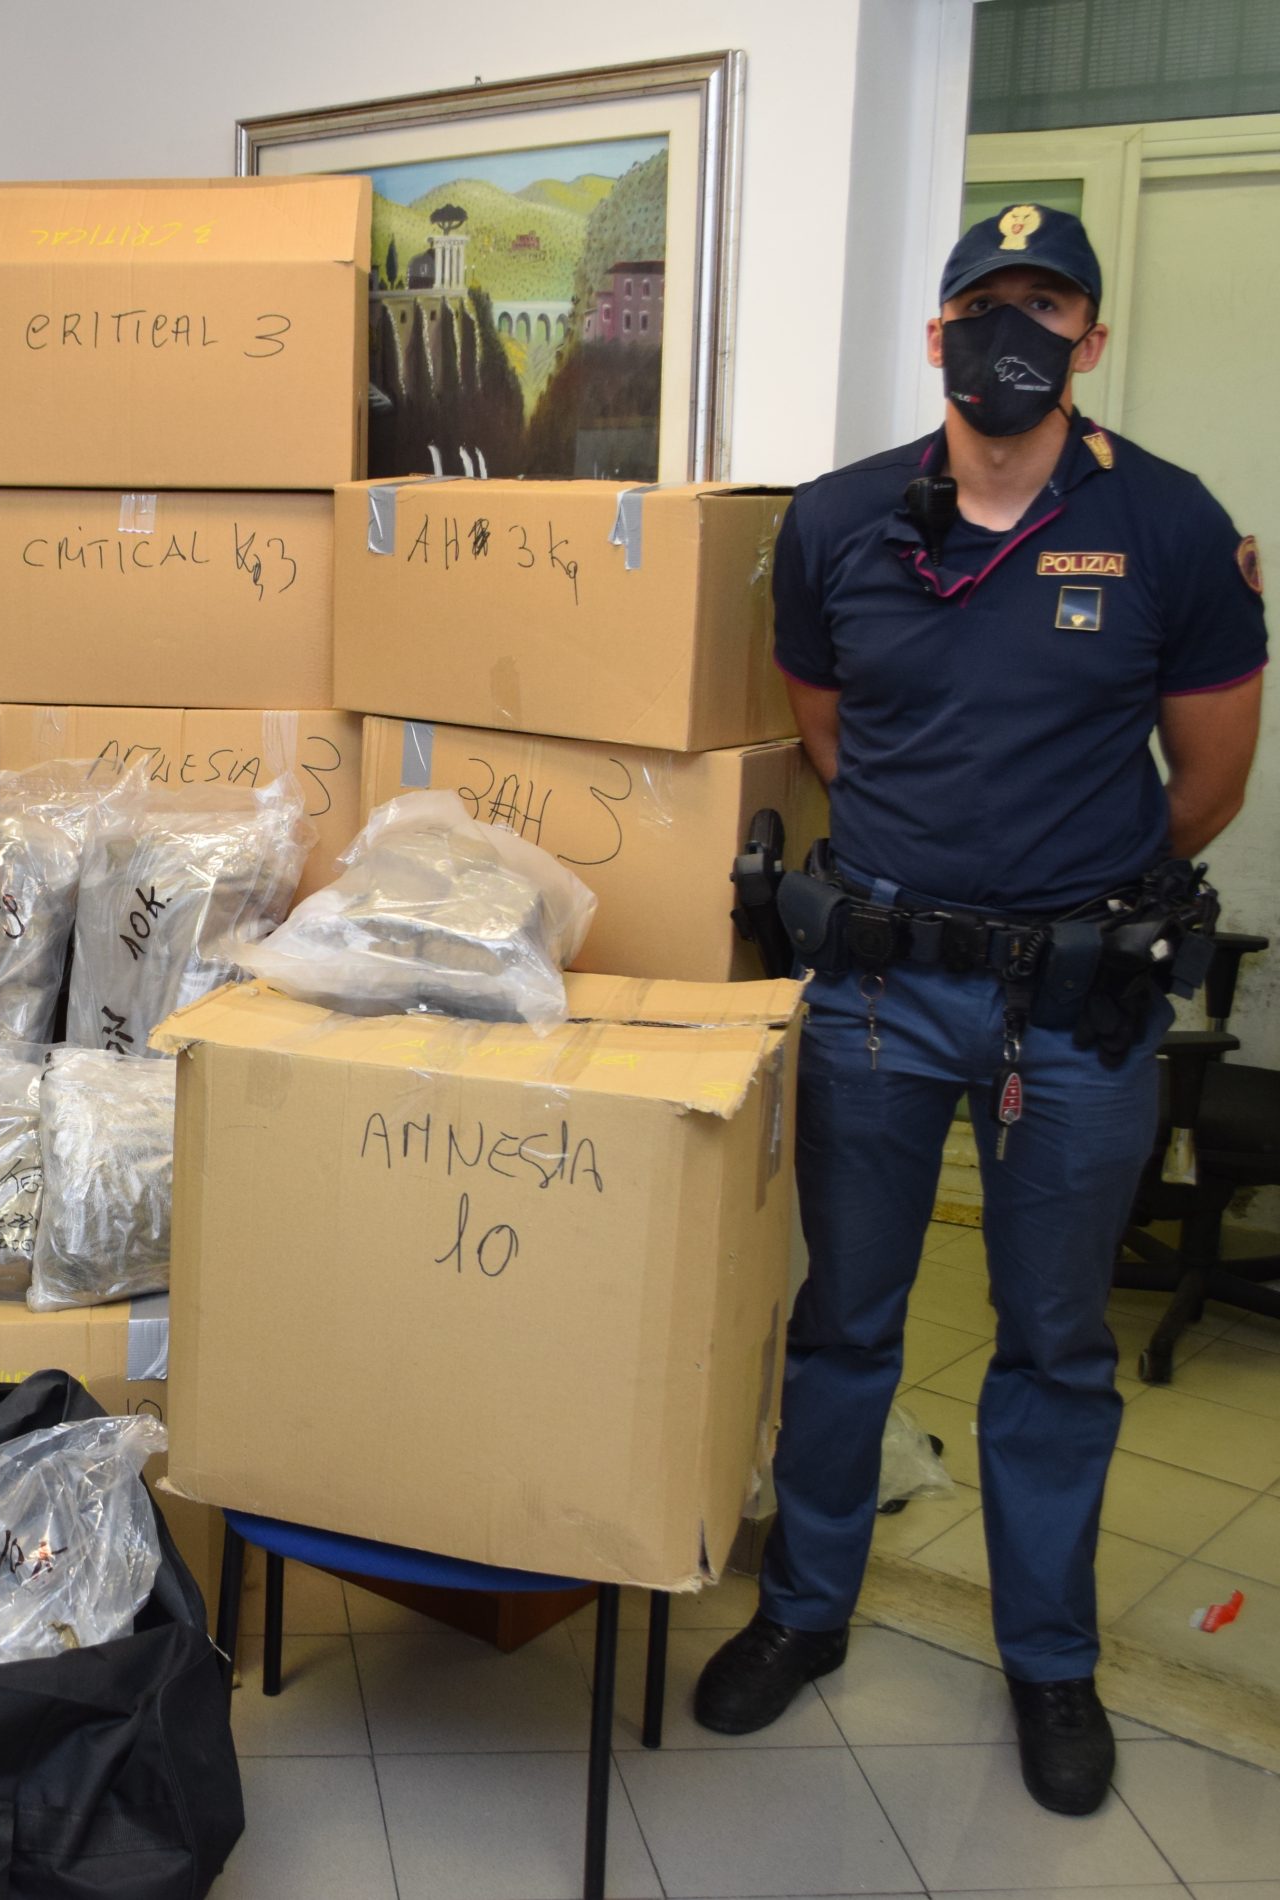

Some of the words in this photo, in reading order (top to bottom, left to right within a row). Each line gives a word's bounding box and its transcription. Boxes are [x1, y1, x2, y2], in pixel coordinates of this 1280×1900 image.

[243, 313, 292, 358] 3
[266, 537, 298, 594] 3
[508, 524, 536, 568] 3
[1039, 555, 1120, 574] POLIZIA
[301, 735, 342, 817] 3
[556, 758, 633, 866] 3
[360, 1111, 604, 1194] AMNESIA
[434, 1192, 520, 1278] 10
